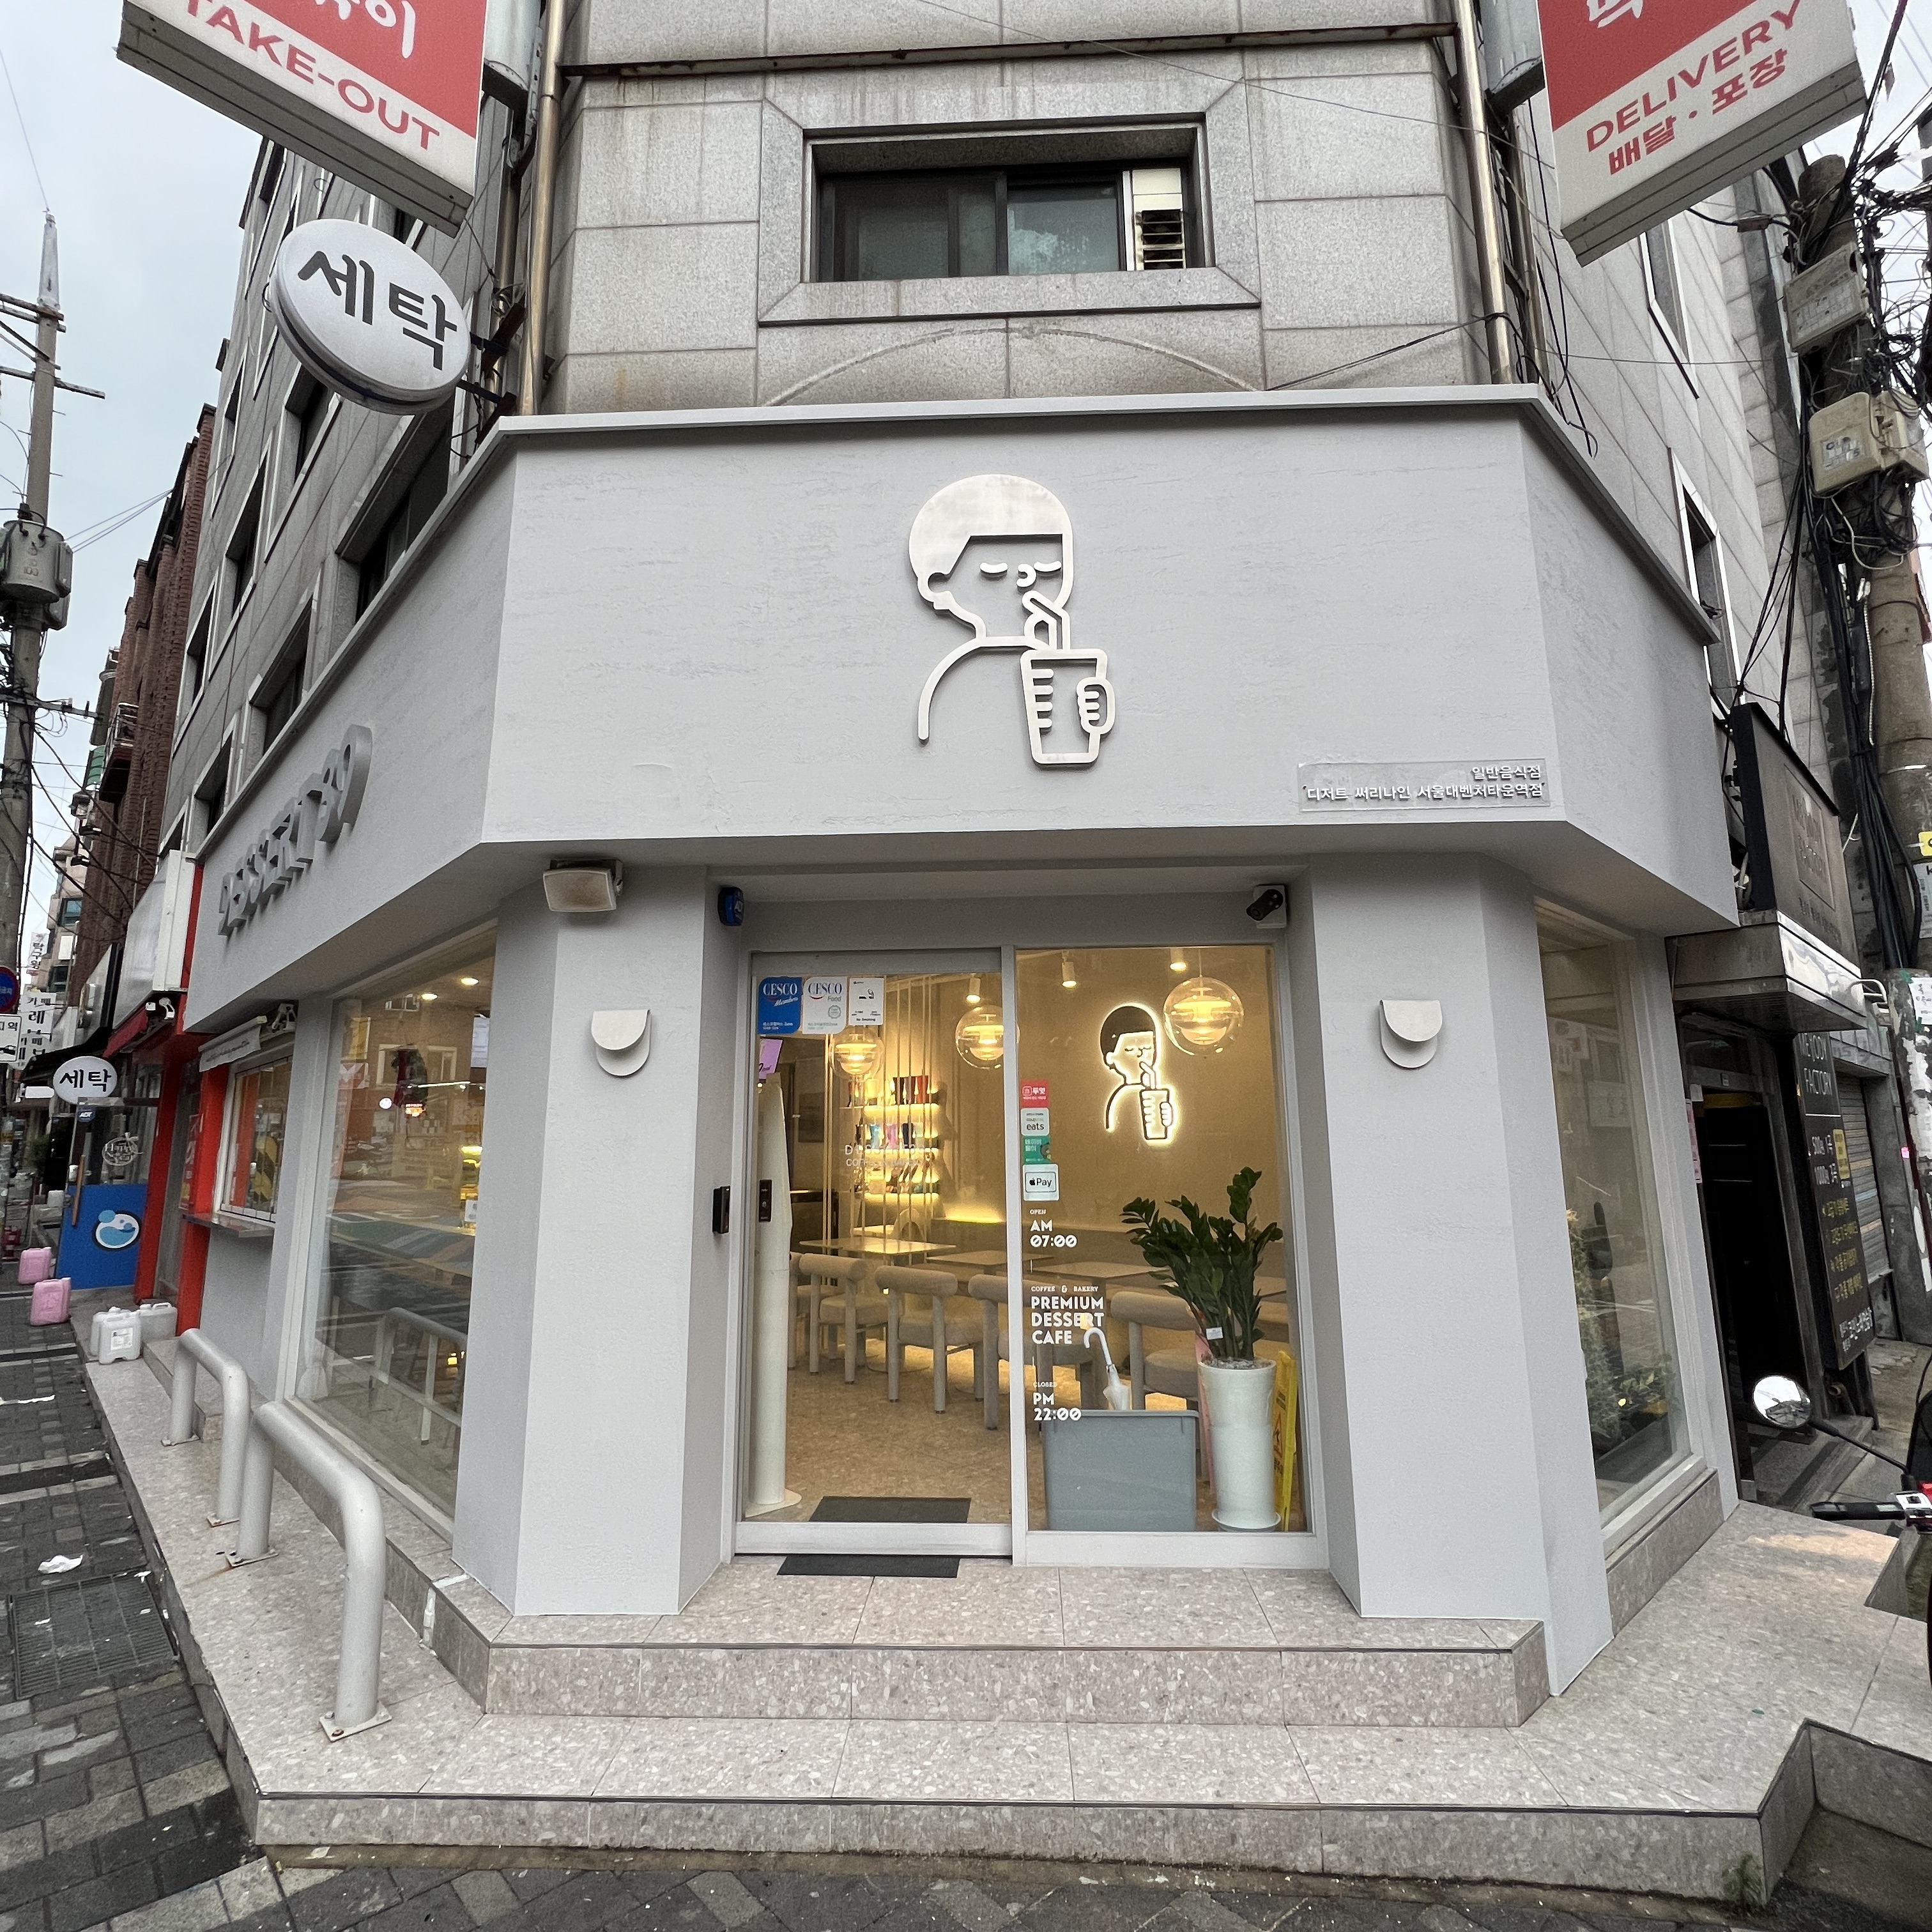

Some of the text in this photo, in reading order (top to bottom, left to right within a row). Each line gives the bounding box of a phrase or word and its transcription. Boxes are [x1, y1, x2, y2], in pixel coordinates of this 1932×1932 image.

[187, 0, 440, 150] TAKE-OUT
[1586, 0, 1800, 153] DELIVERY
[1608, 116, 1676, 175] 배달
[1712, 49, 1788, 116] 포장
[298, 250, 457, 371] 세탁
[1471, 765, 1541, 780] 일반음식점
[1307, 787, 1349, 801] 디저트
[1354, 786, 1411, 800] 써리나인
[763, 983, 798, 995] CESCO
[808, 983, 842, 995] CESCO
[59, 1069, 112, 1092] 세탁
[1026, 1122, 1045, 1130] eats
[1036, 1177, 1052, 1188] Pay
[1030, 1219, 1053, 1232] AM
[1030, 1234, 1077, 1247] 07:00
[1061, 1285, 1068, 1293] &
[1031, 1296, 1103, 1310] PREMIUM
[1031, 1312, 1105, 1327] DESSERT
[1032, 1330, 1072, 1344] CAFE
[1032, 1392, 1054, 1405] PM
[1034, 1407, 1082, 1421] 22:00
